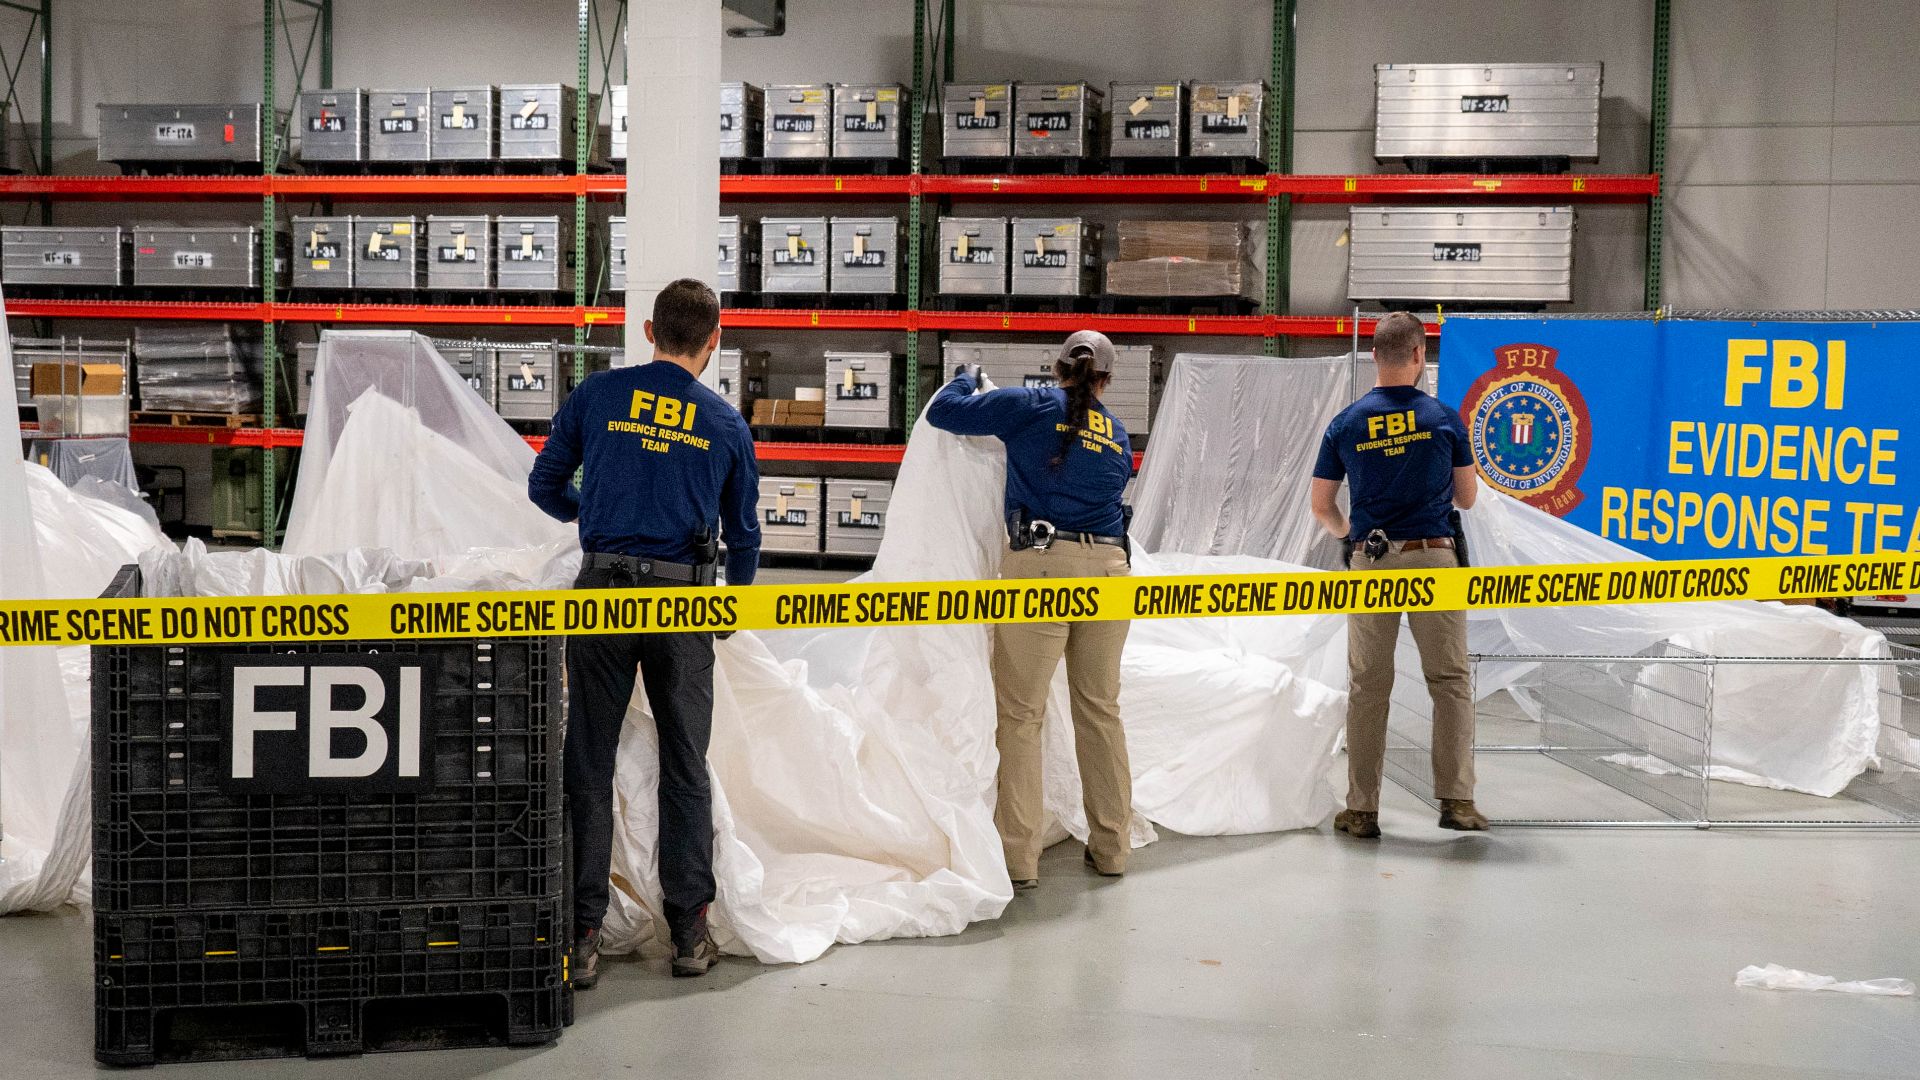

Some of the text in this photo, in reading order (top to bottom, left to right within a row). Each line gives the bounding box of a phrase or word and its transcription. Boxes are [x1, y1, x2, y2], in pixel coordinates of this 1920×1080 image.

[1461, 99, 1507, 112] WF-23A
[313, 118, 341, 131] W-1A
[383, 119, 412, 132] WF-1B
[776, 119, 813, 131] WF-10B
[1028, 116, 1068, 129] WF-17A
[1130, 125, 1171, 139] WF-19B
[1434, 248, 1480, 261] WF-23B
[1505, 348, 1550, 369] FBI
[1725, 339, 1846, 409] FBI
[630, 389, 697, 431] FBI
[1482, 382, 1567, 417] DEPT. OF JUSTICE
[608, 420, 710, 450] EVIDENCE RESPONSE
[1087, 409, 1113, 439] BI
[1367, 410, 1416, 439] FBI
[641, 438, 670, 453] TEAM
[1082, 440, 1102, 453] TEAM
[1356, 431, 1432, 452] EVIDENCE RESPONSE
[1384, 445, 1405, 456] TEAM
[1473, 415, 1572, 489] FEDERAL BUREAU OF INVESTIGATION
[1669, 421, 1898, 485] EVIDENCE
[1551, 489, 1576, 510] Team
[1602, 486, 1831, 555] RESPONSE
[1467, 567, 1749, 604] CRIME SCENE DO NOT CROSS
[1778, 564, 1841, 594] CRIME
[1843, 562, 1906, 591] SCENE
[776, 587, 1099, 624] CRIME SCENE DO NOT CROSS
[1134, 577, 1435, 615] CRIME SCENE DO NOT CROSS
[0, 604, 349, 641] RIME SCENE DO NOT CROSS
[391, 596, 737, 634] CRIME SCENE DO NOT CROSS
[231, 666, 421, 779] FBI
